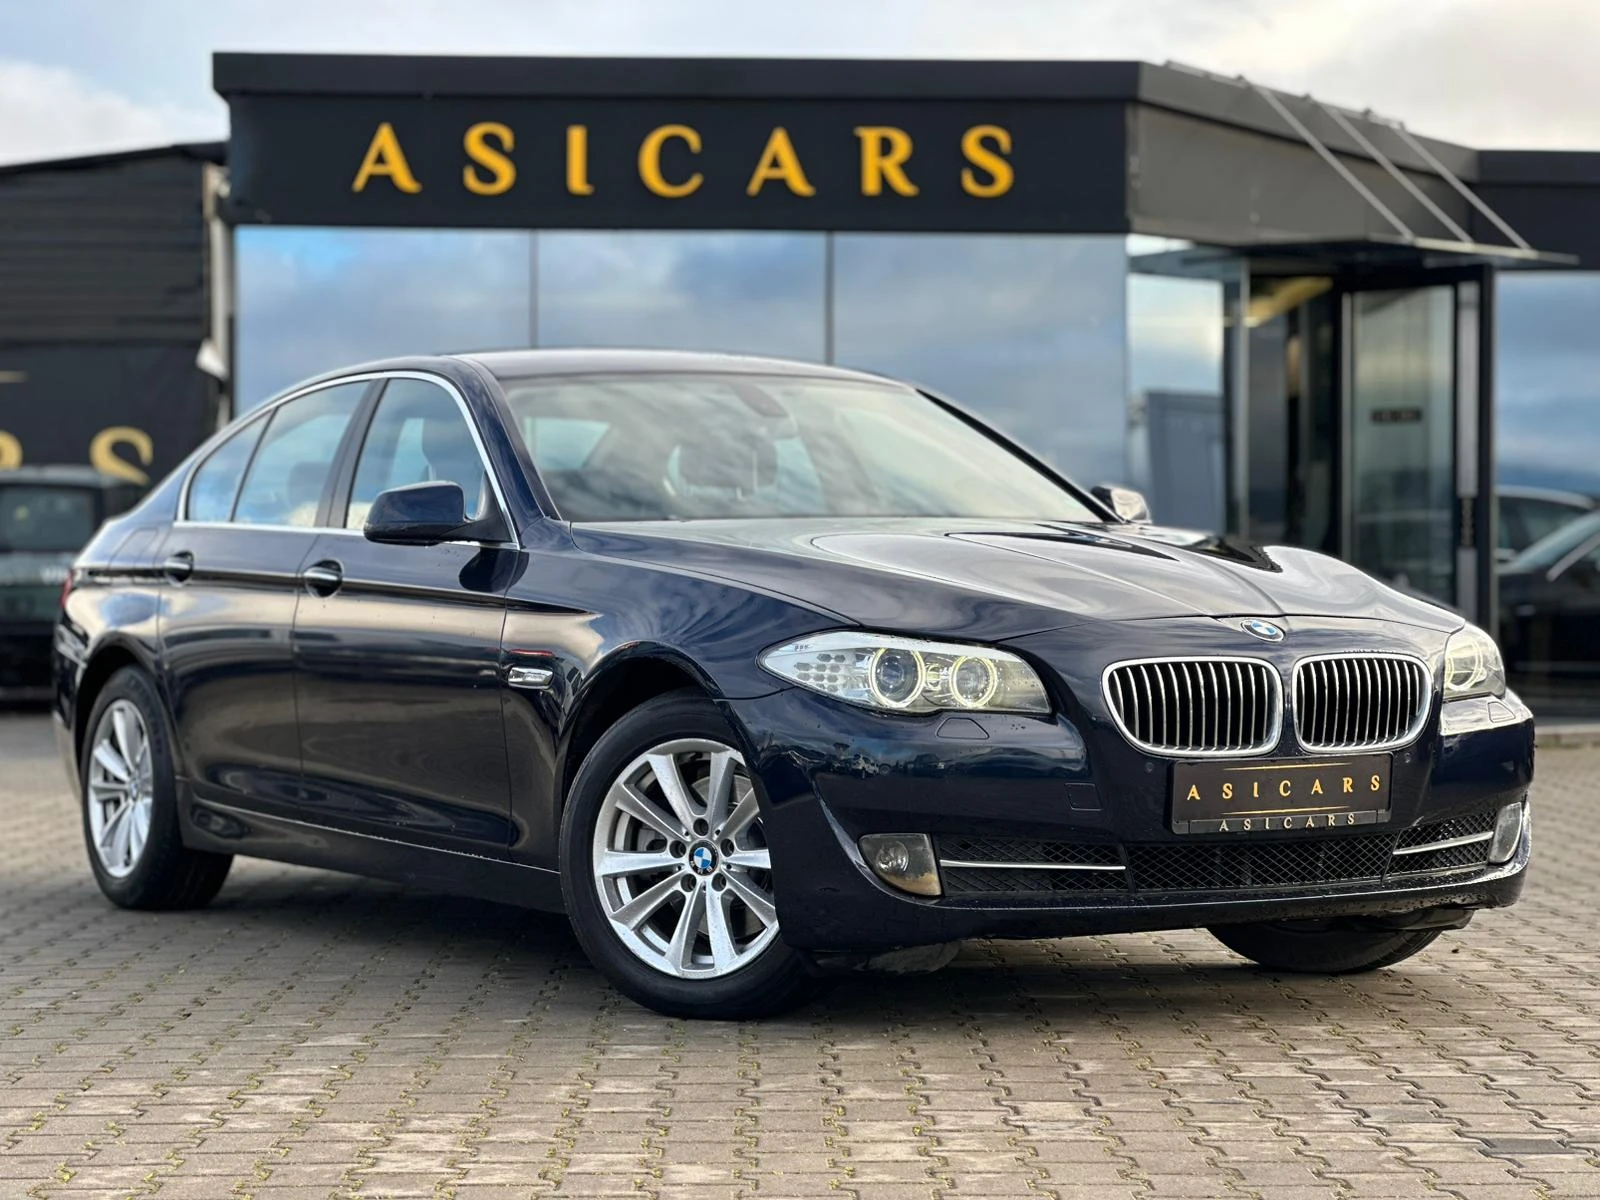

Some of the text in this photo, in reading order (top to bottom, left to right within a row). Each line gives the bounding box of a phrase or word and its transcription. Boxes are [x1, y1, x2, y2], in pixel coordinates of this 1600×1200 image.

[353, 122, 1014, 197] ASICARS
[1187, 775, 1381, 800] ASICARS
[1218, 813, 1356, 832] ASICARS
